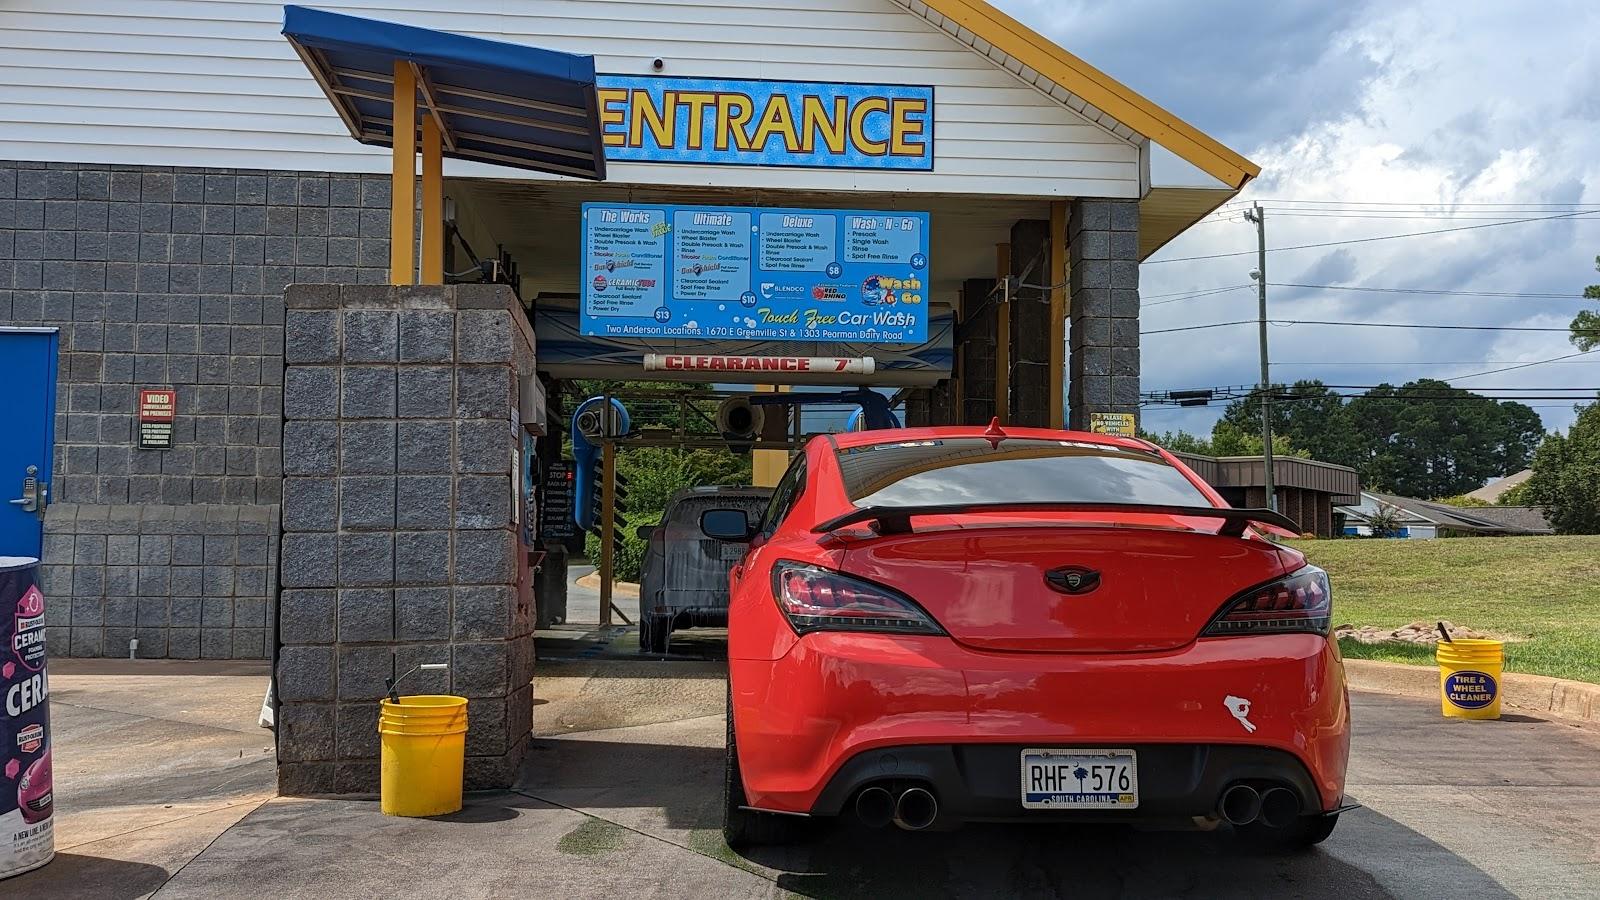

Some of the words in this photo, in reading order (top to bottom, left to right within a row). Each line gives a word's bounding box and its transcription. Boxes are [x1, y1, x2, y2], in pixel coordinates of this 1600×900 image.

[597, 87, 928, 158] ENTRANCE
[601, 210, 617, 223] The
[620, 210, 650, 224] Works
[693, 212, 732, 226] Ultimate
[782, 215, 813, 228] Deluxe
[852, 217, 877, 230] Wash
[885, 218, 893, 230] N
[901, 218, 914, 231] Go
[913, 257, 924, 266] $6
[829, 266, 840, 275] $8
[879, 277, 921, 290] Wash
[901, 292, 922, 304] Go
[757, 307, 800, 325] Touch
[803, 308, 837, 328] Free
[837, 310, 868, 325] Car
[873, 310, 916, 326] Wash
[606, 324, 621, 333] Two
[623, 325, 661, 334] Anderson
[663, 325, 703, 335] Locations:
[705, 326, 727, 336] 1670
[729, 327, 734, 336] E
[736, 327, 777, 338] Greenville
[779, 328, 788, 337] St
[789, 329, 796, 338] &
[800, 328, 820, 338] 1303
[822, 329, 858, 339] Pearman
[859, 329, 880, 340] Dairy
[883, 330, 903, 340] Road
[665, 356, 810, 372] CLEARANCE
[146, 394, 169, 404] VIDEO
[549, 471, 566, 479] STOP
[1453, 684, 1487, 692] WHEEL
[1450, 693, 1492, 701] CLEANER
[18, 731, 43, 744] RUST-OLEUM
[1031, 765, 1069, 791] RHF
[1091, 765, 1130, 791] 576
[1051, 794, 1074, 802] SOUTH
[13, 832, 17, 841] A
[18, 830, 28, 840] NEW
